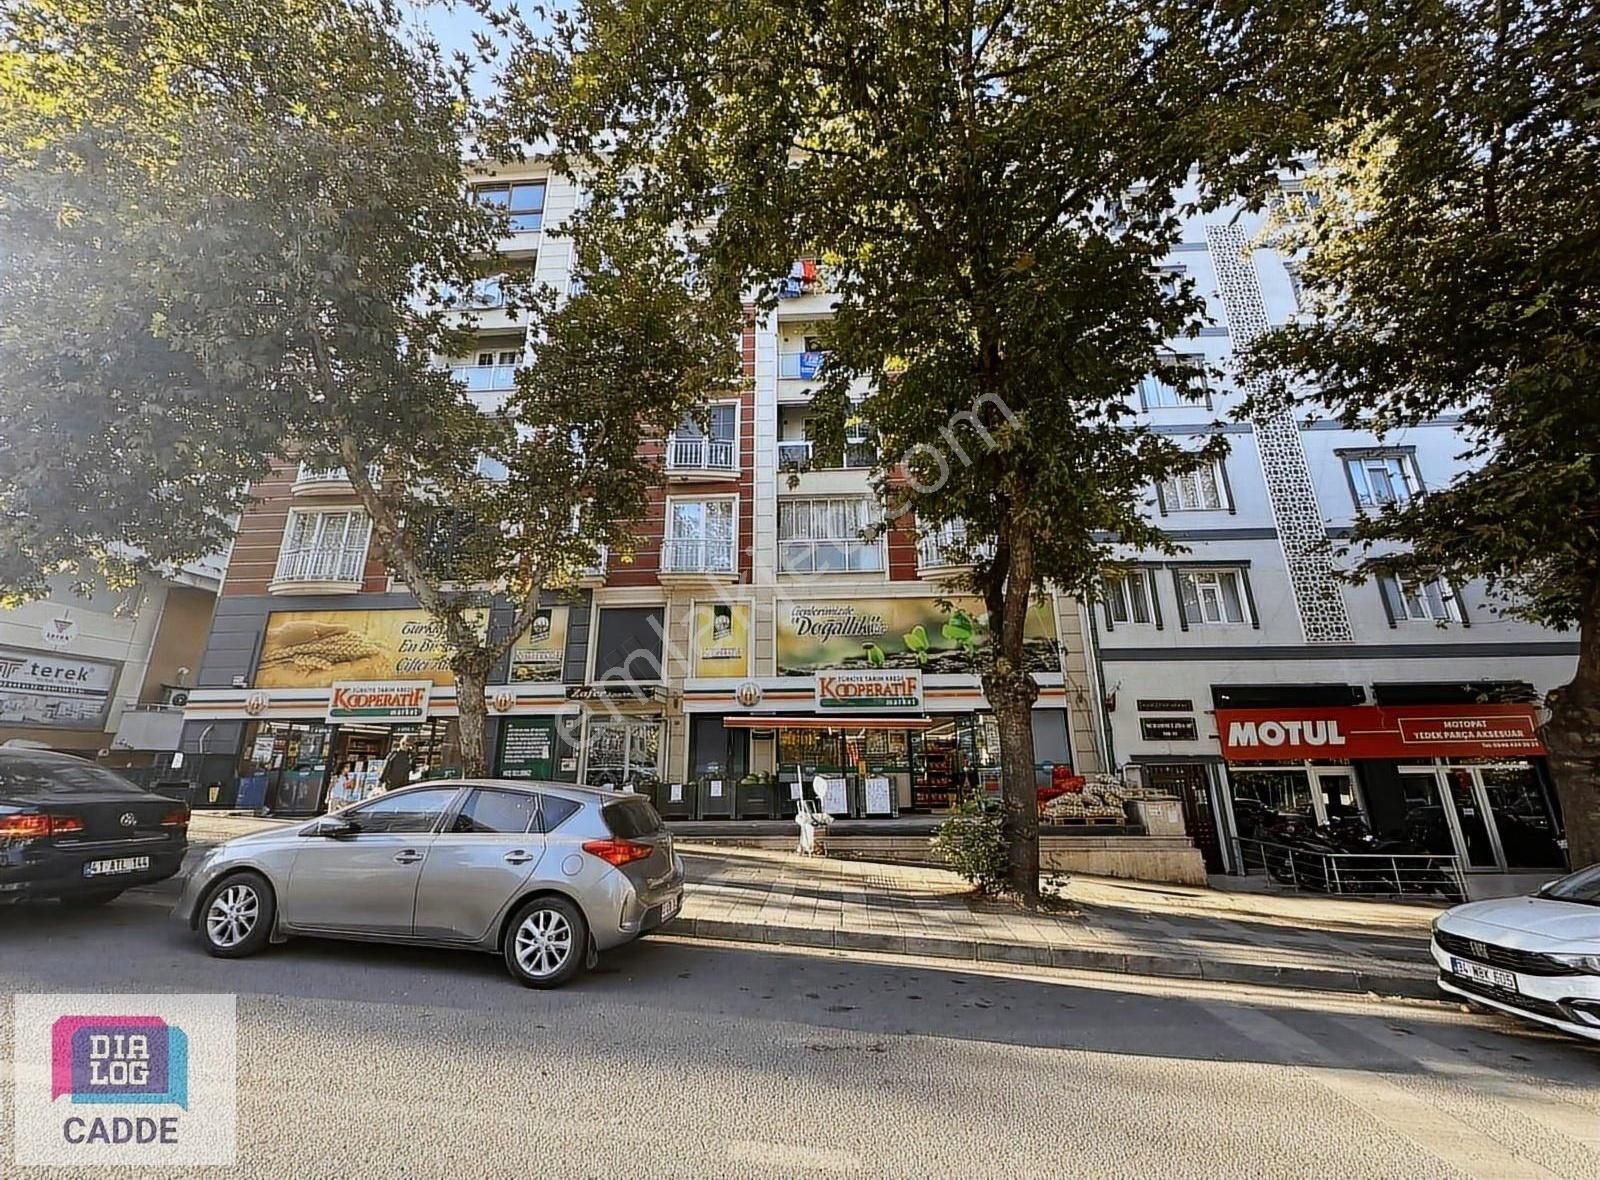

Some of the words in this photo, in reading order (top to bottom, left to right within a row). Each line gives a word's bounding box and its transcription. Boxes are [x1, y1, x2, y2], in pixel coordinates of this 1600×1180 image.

[31, 662, 89, 681] terek
[1228, 721, 1346, 747] MOTUL
[1445, 731, 1475, 740] PARÇA
[1476, 730, 1524, 739] AKSESUAR
